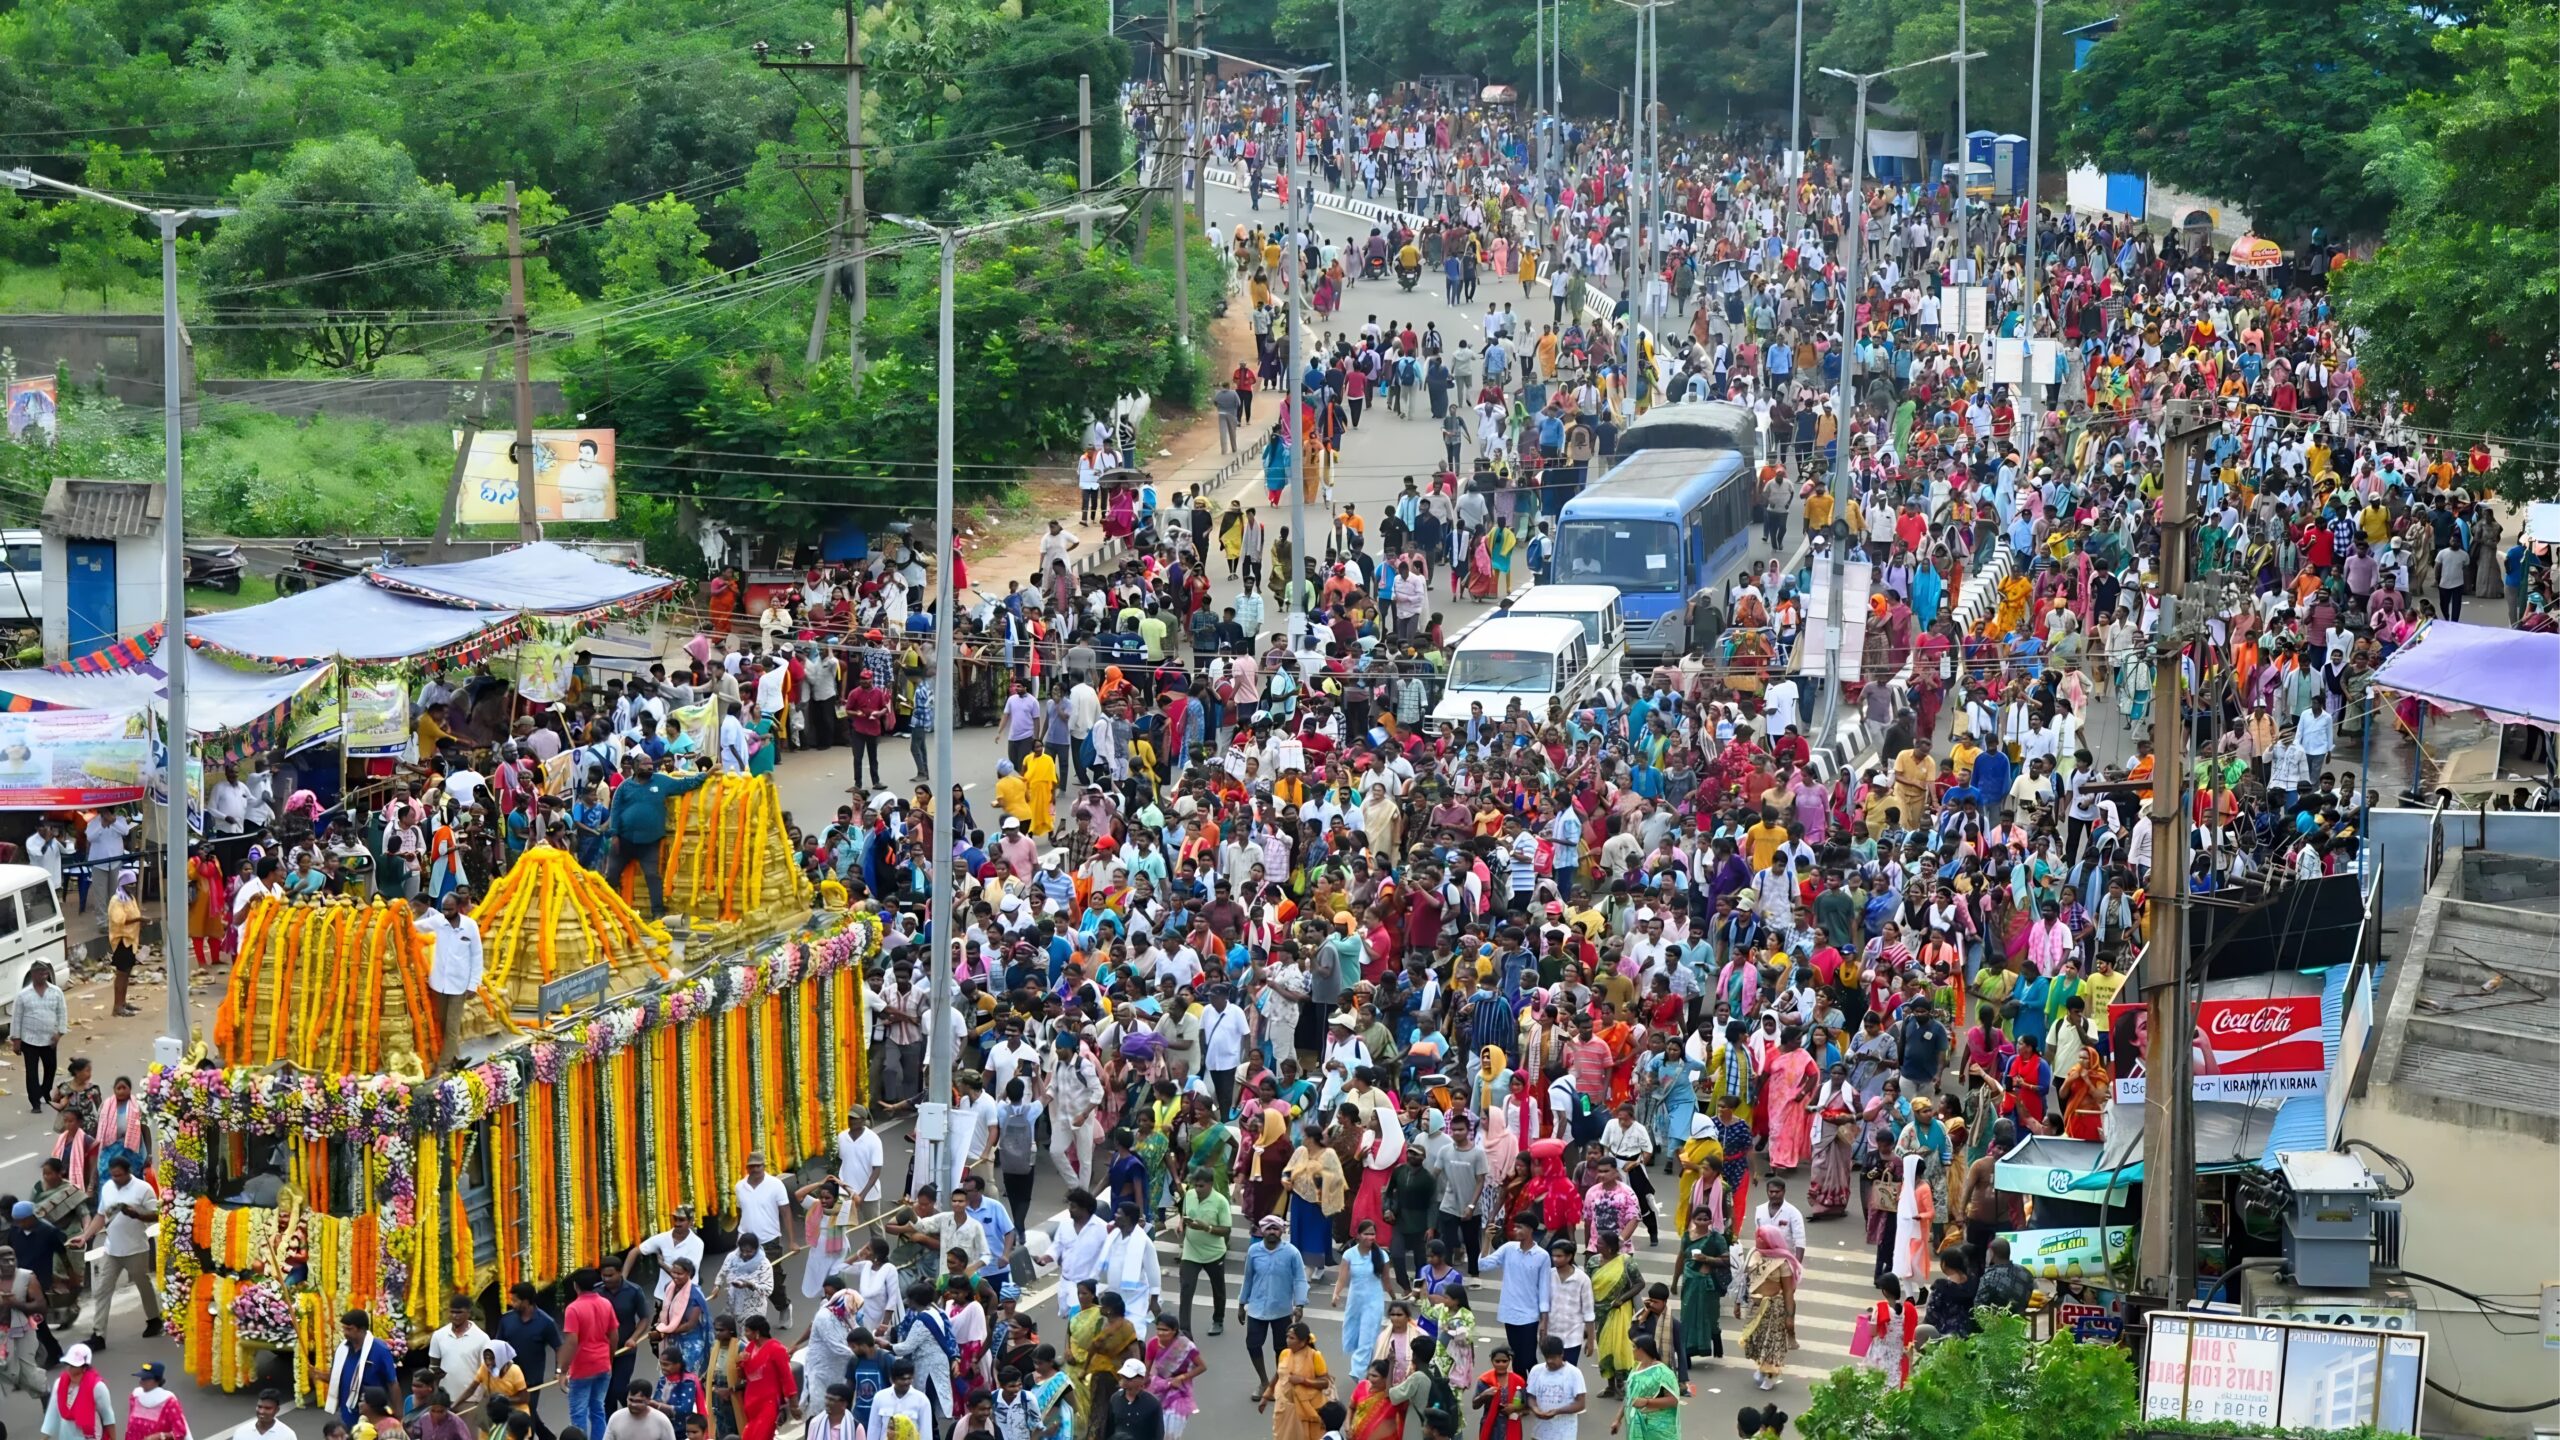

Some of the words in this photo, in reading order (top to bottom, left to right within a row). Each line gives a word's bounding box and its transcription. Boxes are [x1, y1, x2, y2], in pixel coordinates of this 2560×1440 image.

[2211, 1006, 2294, 1034] Coca-Cola
[2223, 1078, 2278, 1093] KIRANMAYI
[2280, 1076, 2318, 1090] KIRANA
